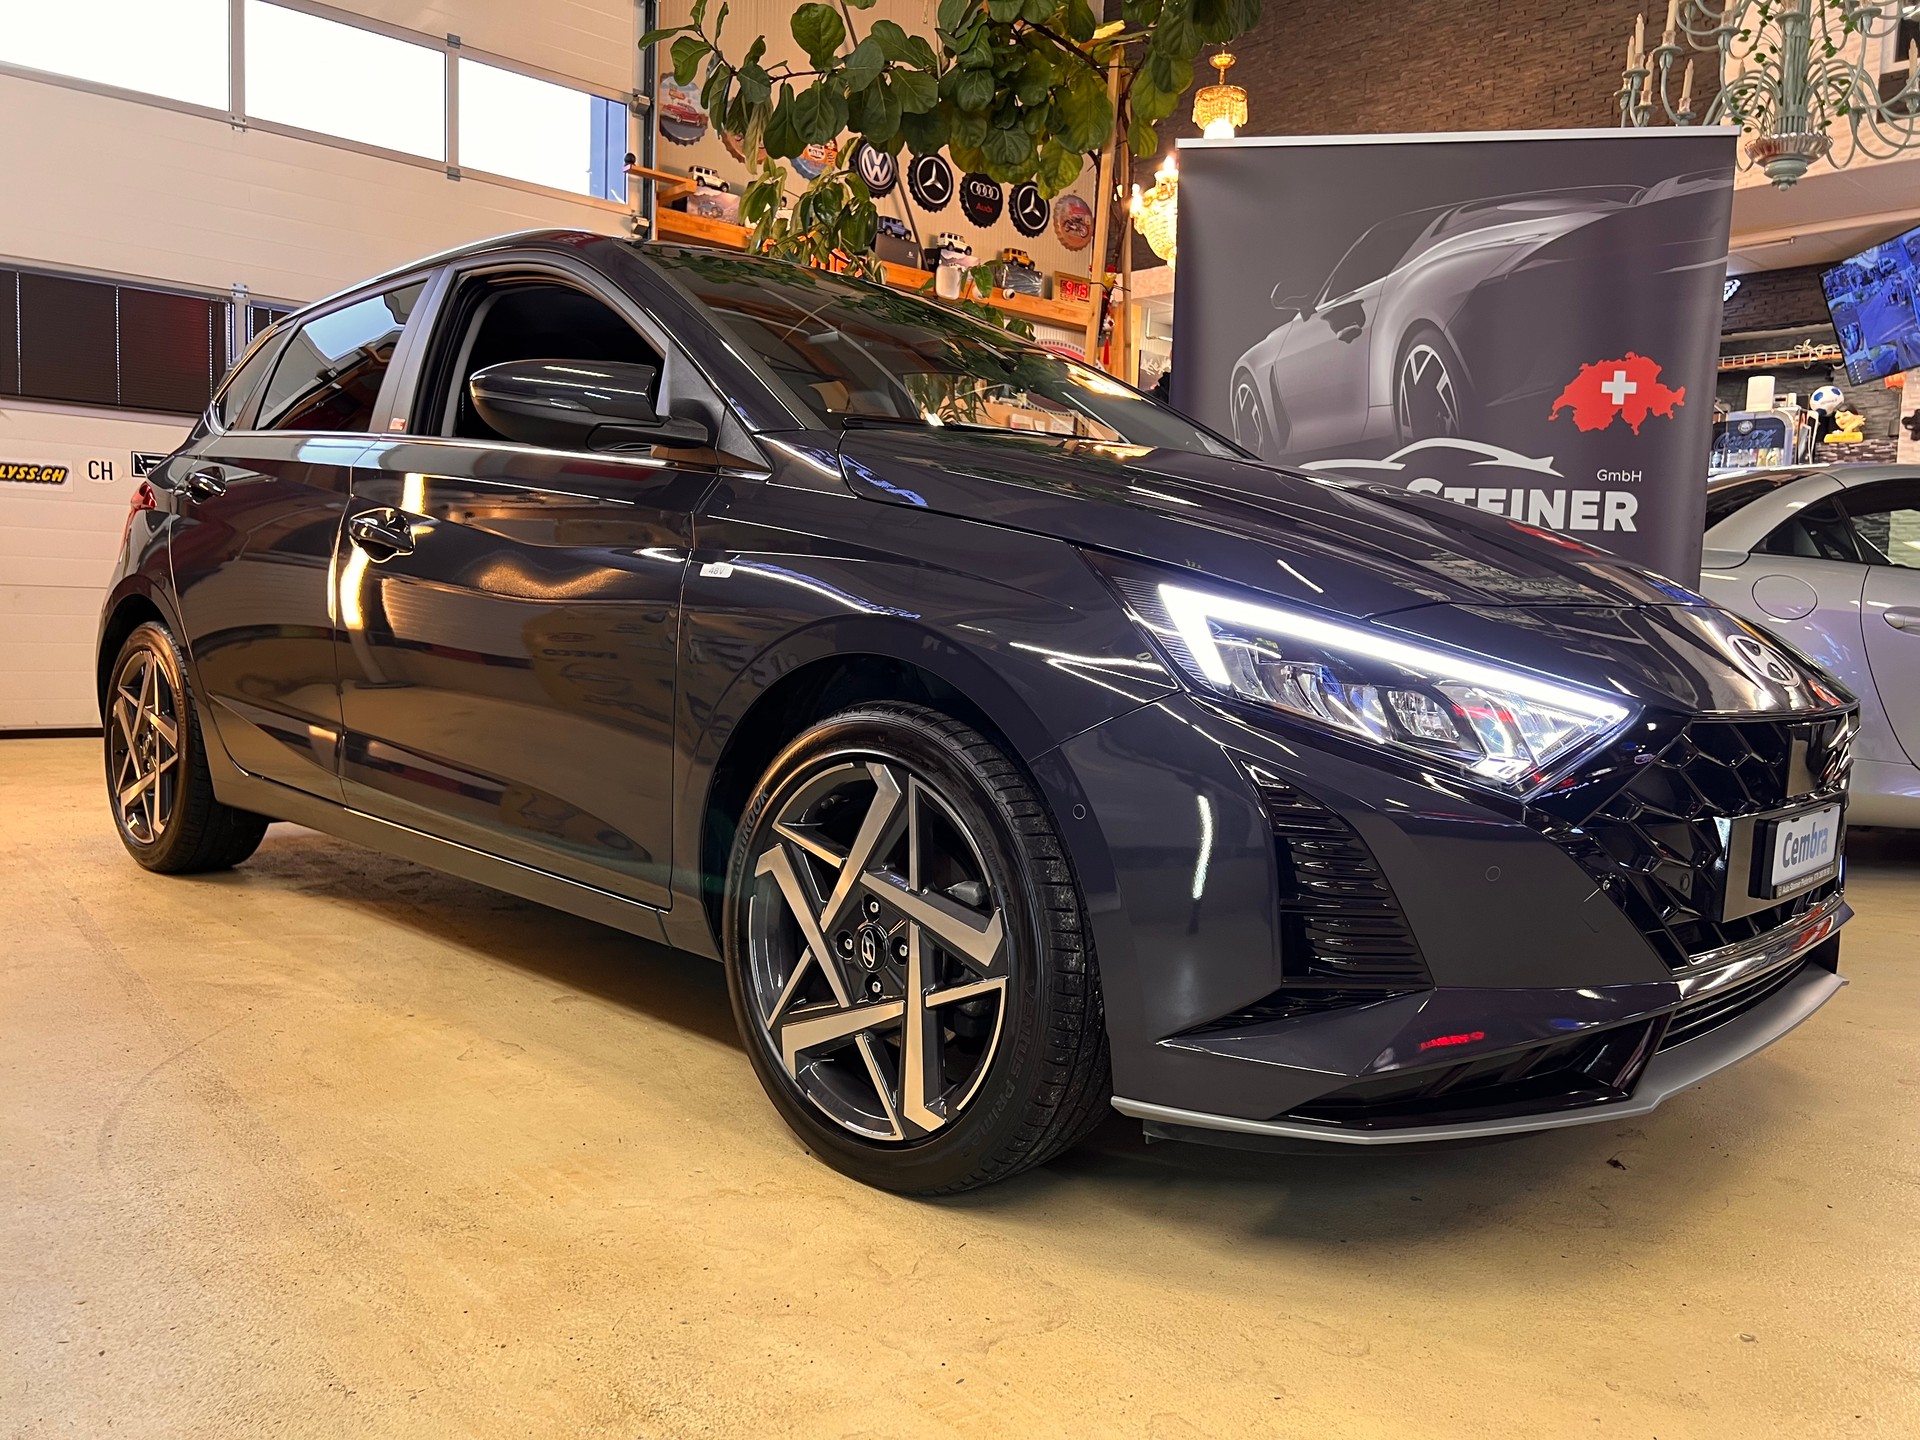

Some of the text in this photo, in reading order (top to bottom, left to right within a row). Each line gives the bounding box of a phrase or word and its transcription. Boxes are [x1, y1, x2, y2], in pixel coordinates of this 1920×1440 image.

[975, 202, 993, 213] Audi
[88, 460, 113, 480] CH
[1596, 469, 1643, 482] GmbH
[1782, 821, 1829, 868] Cembra
